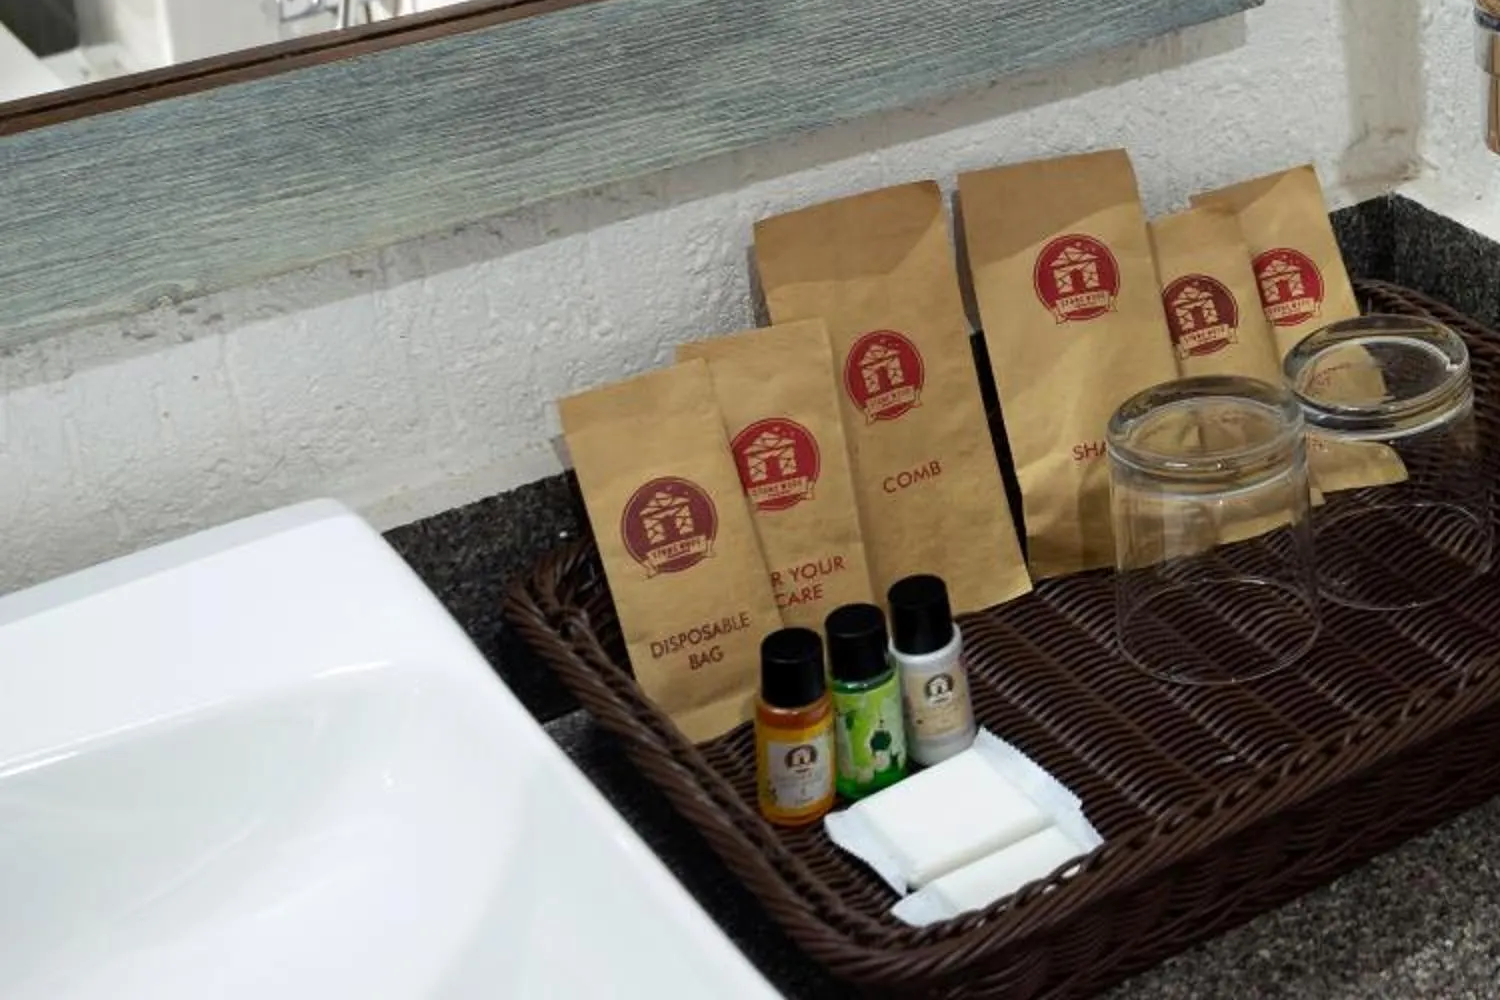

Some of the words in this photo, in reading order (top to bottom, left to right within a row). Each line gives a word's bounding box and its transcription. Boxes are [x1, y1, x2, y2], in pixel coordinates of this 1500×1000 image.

[882, 460, 941, 494] COMB
[787, 555, 845, 581] YOUR
[774, 583, 824, 608] CARE
[650, 610, 751, 659] DISPOSABLE
[688, 645, 724, 671] BAG
